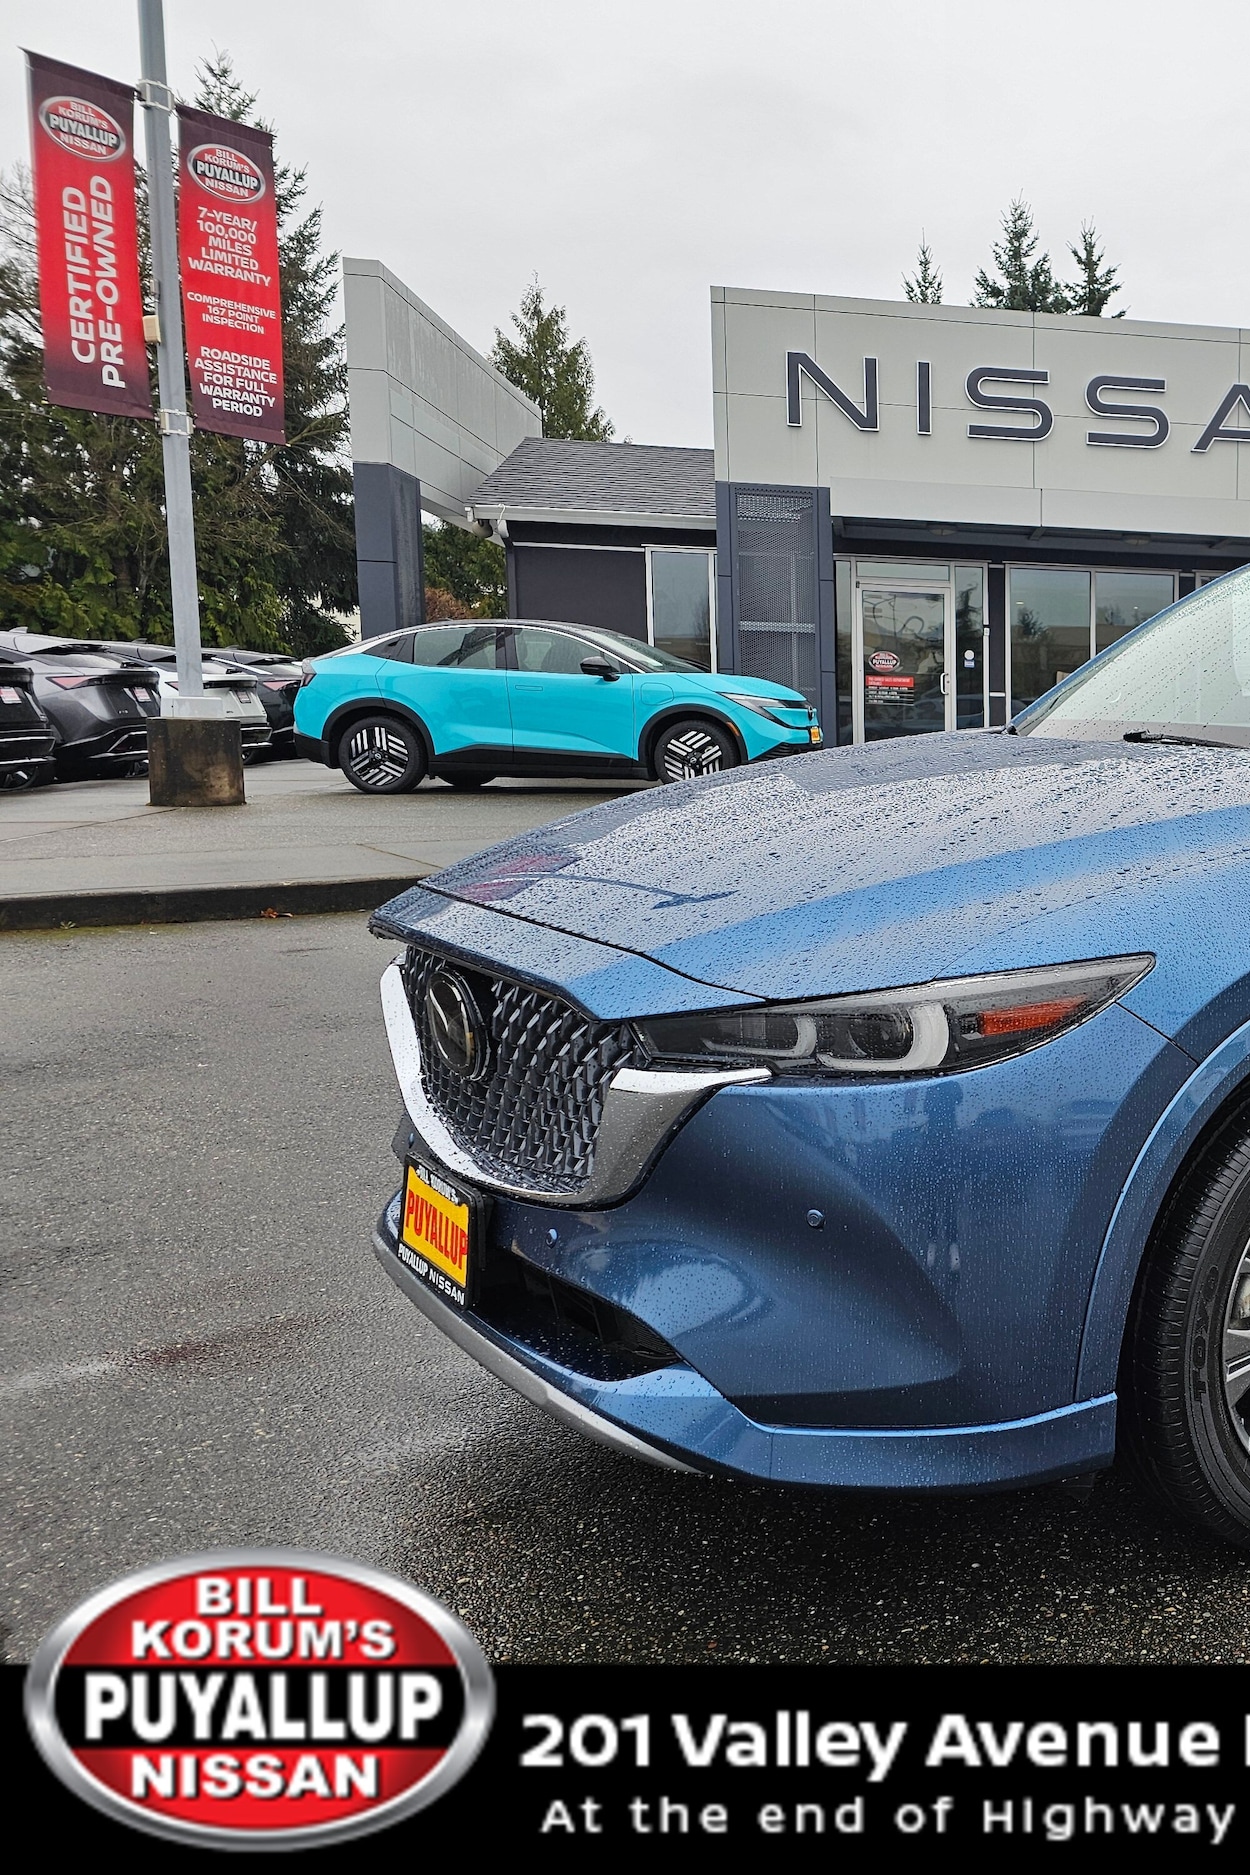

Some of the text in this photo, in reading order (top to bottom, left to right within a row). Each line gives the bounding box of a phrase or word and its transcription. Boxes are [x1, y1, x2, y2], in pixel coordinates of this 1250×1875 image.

[58, 106, 109, 129] KORUM'S
[69, 101, 96, 117] BILL
[49, 113, 118, 147] PUYALLUP
[60, 132, 107, 155] NISSAN
[215, 149, 238, 163] BILL
[196, 161, 259, 191] PUYALLUP
[204, 153, 250, 174] KORUM'S
[205, 178, 249, 198] NISSAN
[198, 206, 258, 233] 7-YEAR/
[197, 220, 257, 245] 100,000
[201, 247, 259, 271] LIMITED
[208, 236, 253, 257] MILES
[62, 186, 96, 364] CERTIFIED
[90, 175, 126, 389] PRE-OWNED
[188, 257, 271, 287] WARRANTY
[187, 291, 276, 320] COMPREHENSIVE
[207, 305, 260, 324] 167 POINT
[202, 313, 265, 335] INSPECTION
[200, 346, 271, 371] ROADSIDE
[194, 358, 277, 385] ASSISTANCE
[203, 371, 268, 395] FOR FULL
[199, 382, 276, 408] WARRANTY
[212, 397, 263, 418] PERIOD
[405, 1188, 469, 1271] PUYALLUP
[398, 1242, 465, 1307] PUYALLUP NISSAN
